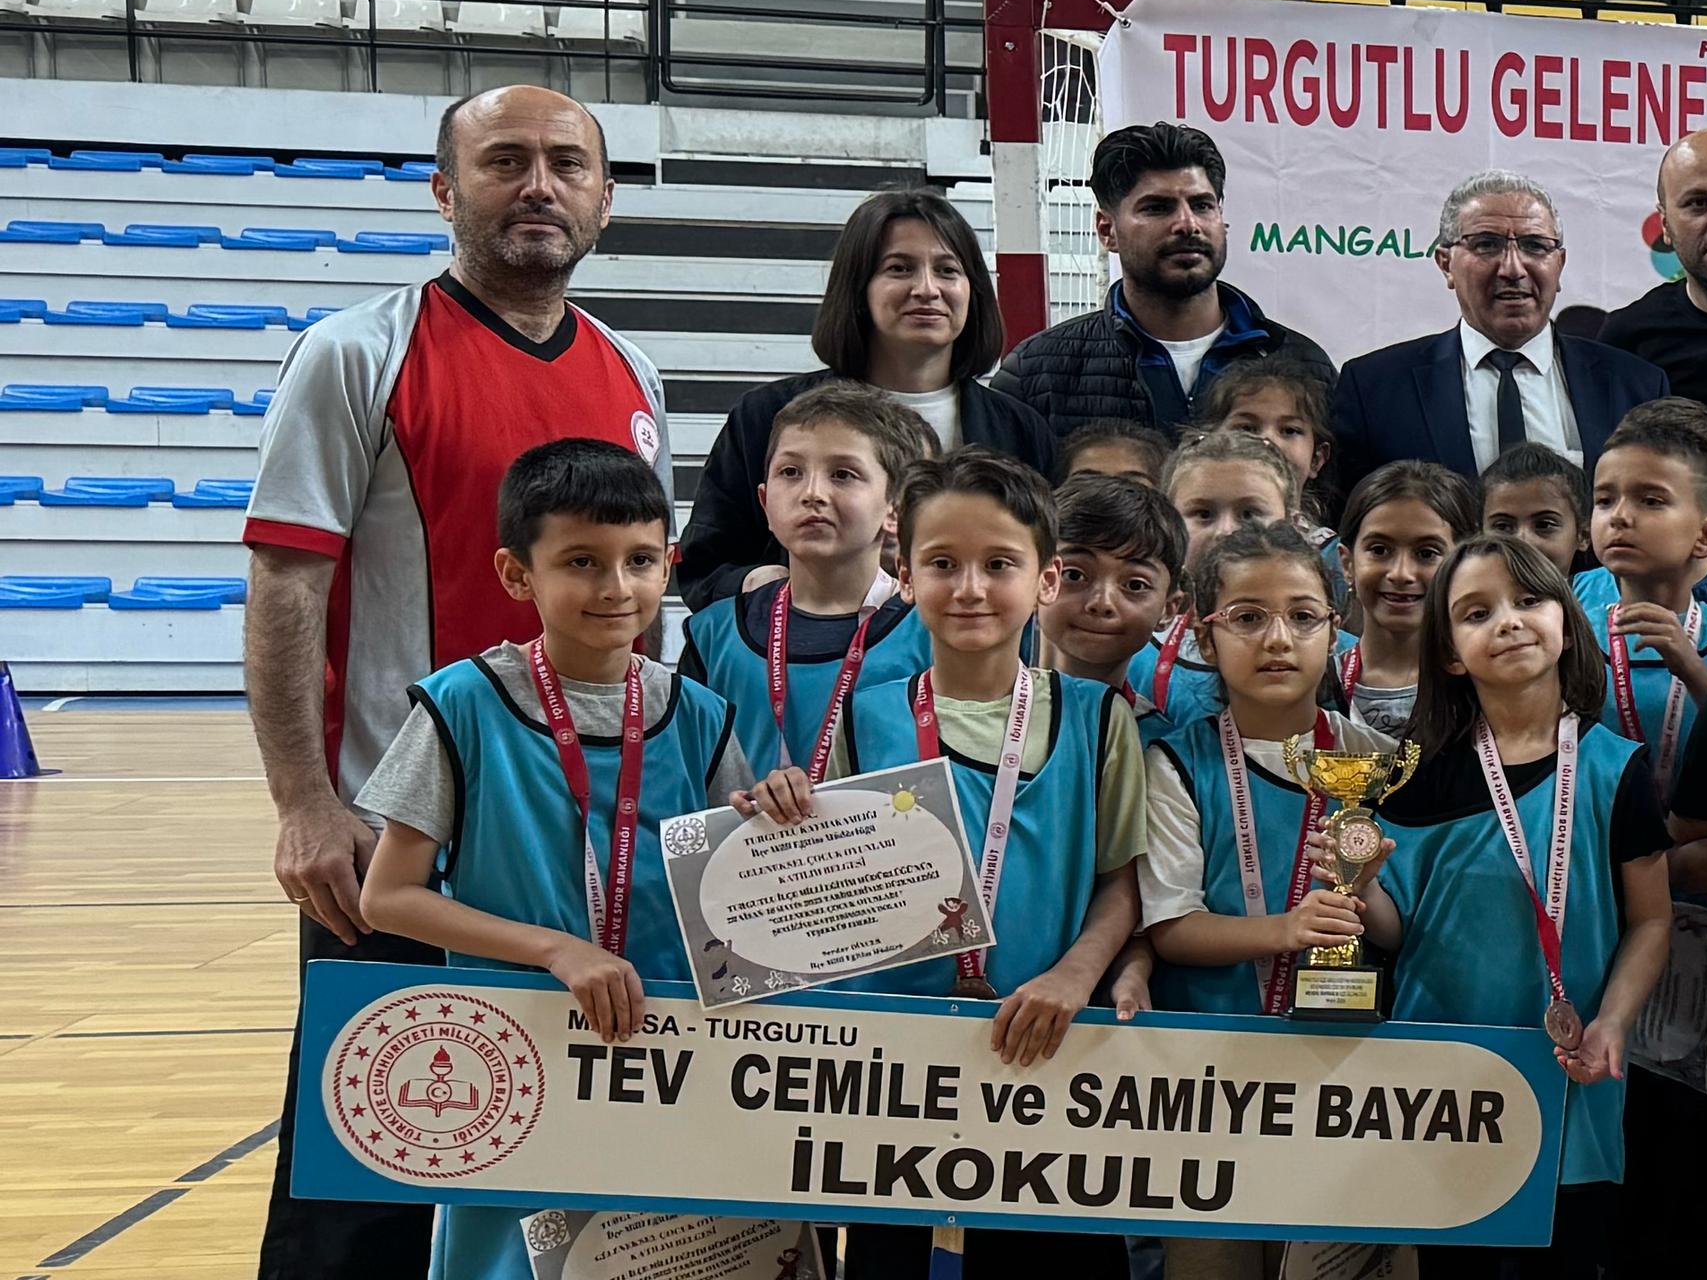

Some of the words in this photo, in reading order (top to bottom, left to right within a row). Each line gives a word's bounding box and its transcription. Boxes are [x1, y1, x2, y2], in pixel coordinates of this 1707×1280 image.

[1163, 33, 1470, 133] TURGUTLU
[373, 1025, 435, 1096] CUMHURİYETİ
[439, 1026, 479, 1046] MİLLİ
[705, 1016, 858, 1048] TURGUTLU
[477, 1041, 507, 1084] EĞİTİM
[375, 1097, 422, 1142] TÜRKİYE
[453, 1086, 507, 1144] BAKANLIĞI
[568, 1043, 695, 1106] TEV
[730, 1047, 961, 1122] CEMİLE
[980, 1080, 1046, 1126] ve
[1065, 1064, 1297, 1138] SAMİYE
[1315, 1085, 1506, 1145] BAYAR
[790, 1125, 1238, 1213] İLKOKULU
